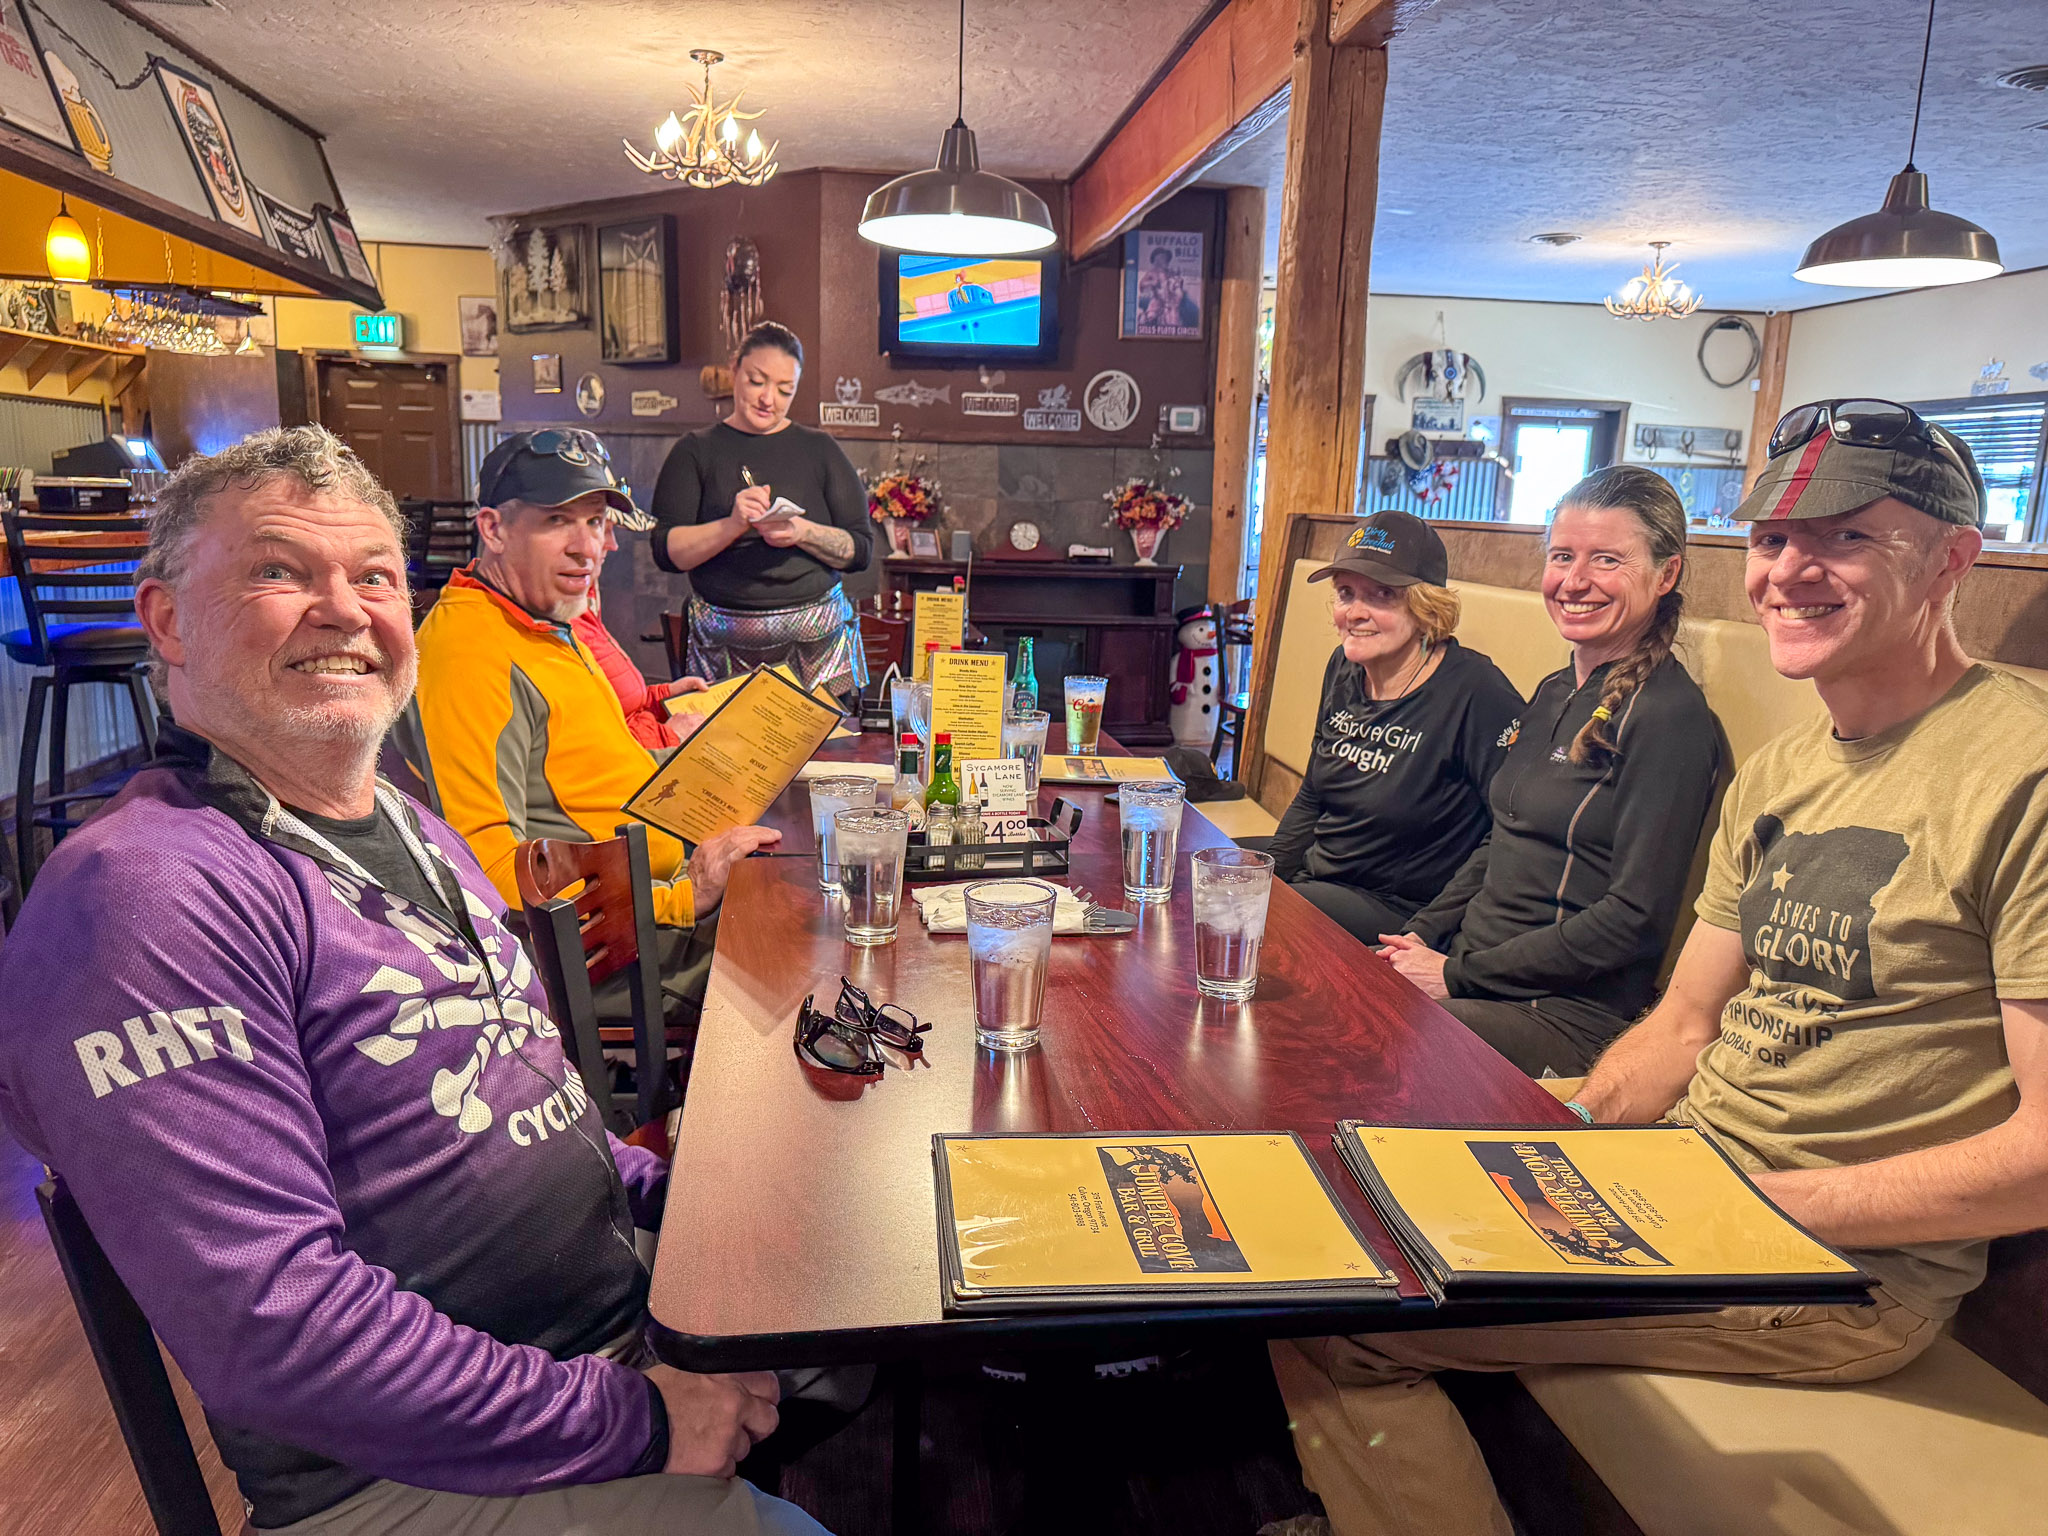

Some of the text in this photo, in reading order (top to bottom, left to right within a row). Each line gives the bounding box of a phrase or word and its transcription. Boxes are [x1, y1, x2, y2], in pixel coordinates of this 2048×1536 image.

[1147, 235, 1198, 246] BUFFALO
[1175, 248, 1199, 258] BILL
[355, 315, 396, 343] EXIT
[823, 407, 875, 423] WELCOME
[966, 395, 1016, 412] WELCOME
[1027, 413, 1079, 429] WELCOME
[949, 657, 989, 667] DRINK MENU
[966, 763, 1021, 772] SYCAMORE
[995, 772, 1022, 780] LANE
[1768, 897, 1853, 942] ASHES TO
[1754, 924, 1861, 981] GLORY
[72, 1005, 255, 1100] RHFT
[1757, 1046, 1788, 1069] OR
[1510, 1144, 1624, 1249] JUNIPER COVE
[1548, 1156, 1622, 1228] BAR & GRILL
[1116, 1186, 1160, 1259] BAR & GRILL
[1127, 1164, 1199, 1271] JUNIPER COVE
